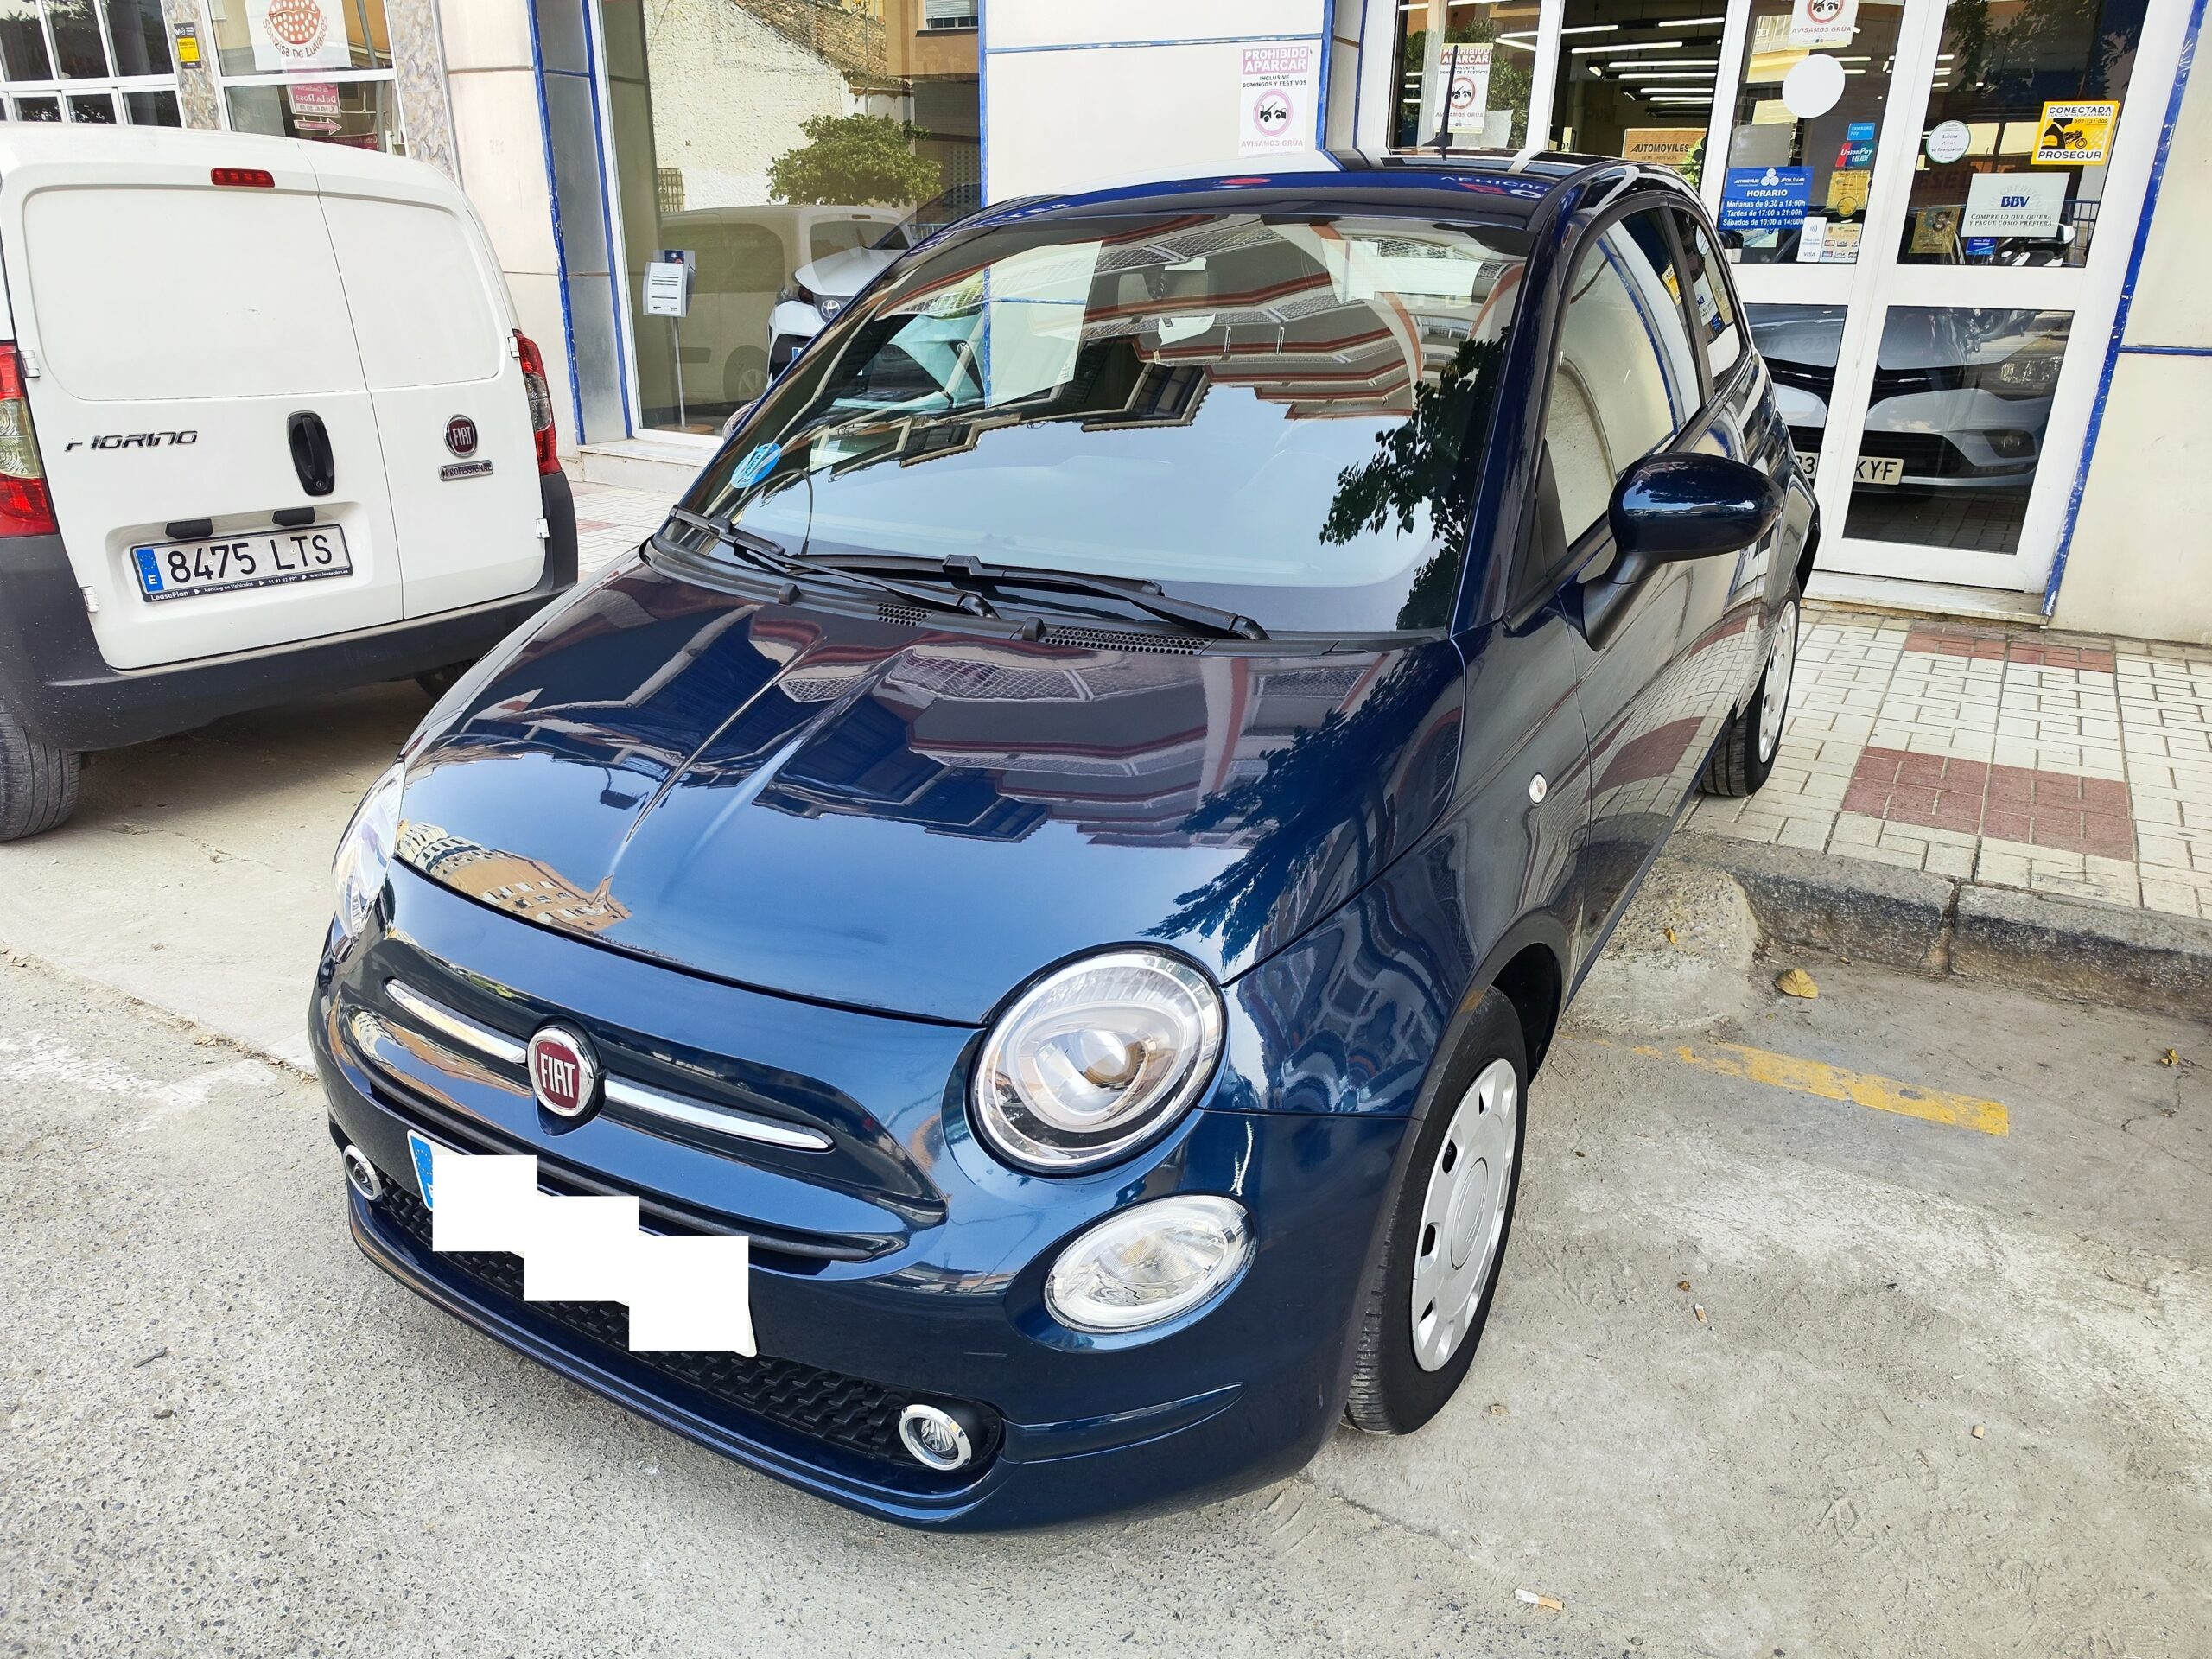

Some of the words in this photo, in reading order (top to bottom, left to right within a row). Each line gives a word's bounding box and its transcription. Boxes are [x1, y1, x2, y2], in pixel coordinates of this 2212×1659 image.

[1244, 48, 1307, 60] PROHIBIDO
[1245, 59, 1307, 73] APARCAR
[2049, 105, 2112, 114] CONECTADA
[1630, 143, 1690, 153] AUTOMOVILES
[1840, 147, 1873, 156] UnionPay
[2037, 150, 2102, 159] PROSEGUR
[1785, 199, 1806, 207] 14:00h
[2001, 195, 2031, 207] BBV
[452, 427, 472, 446] FIAT
[444, 462, 493, 477] PROFESSIONAL
[167, 543, 257, 584] 8475
[270, 534, 333, 571] LTS
[147, 575, 157, 586] E
[150, 591, 189, 601] LeasePlan
[540, 1052, 576, 1099] FIAT
